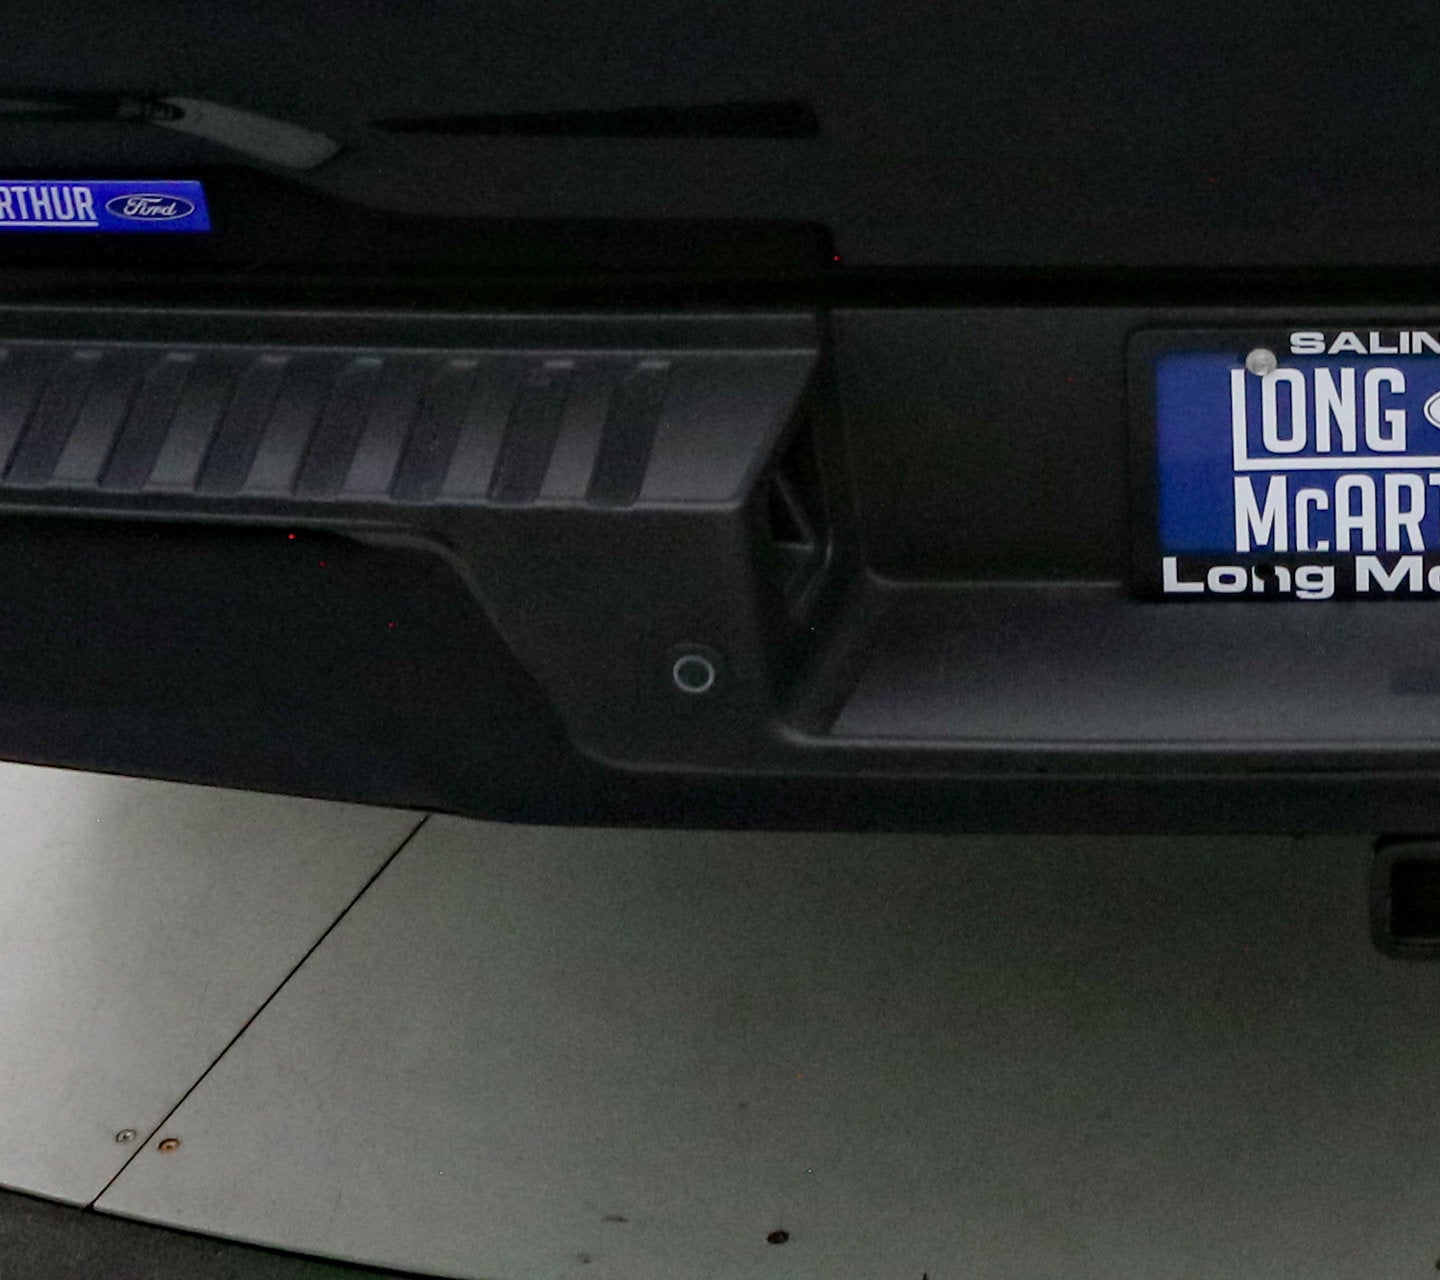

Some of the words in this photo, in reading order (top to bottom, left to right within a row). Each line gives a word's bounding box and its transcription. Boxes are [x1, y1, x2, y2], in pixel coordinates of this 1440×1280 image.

[123, 197, 177, 217] Ford
[1231, 367, 1406, 471] LONG
[1162, 556, 1335, 600] Long
